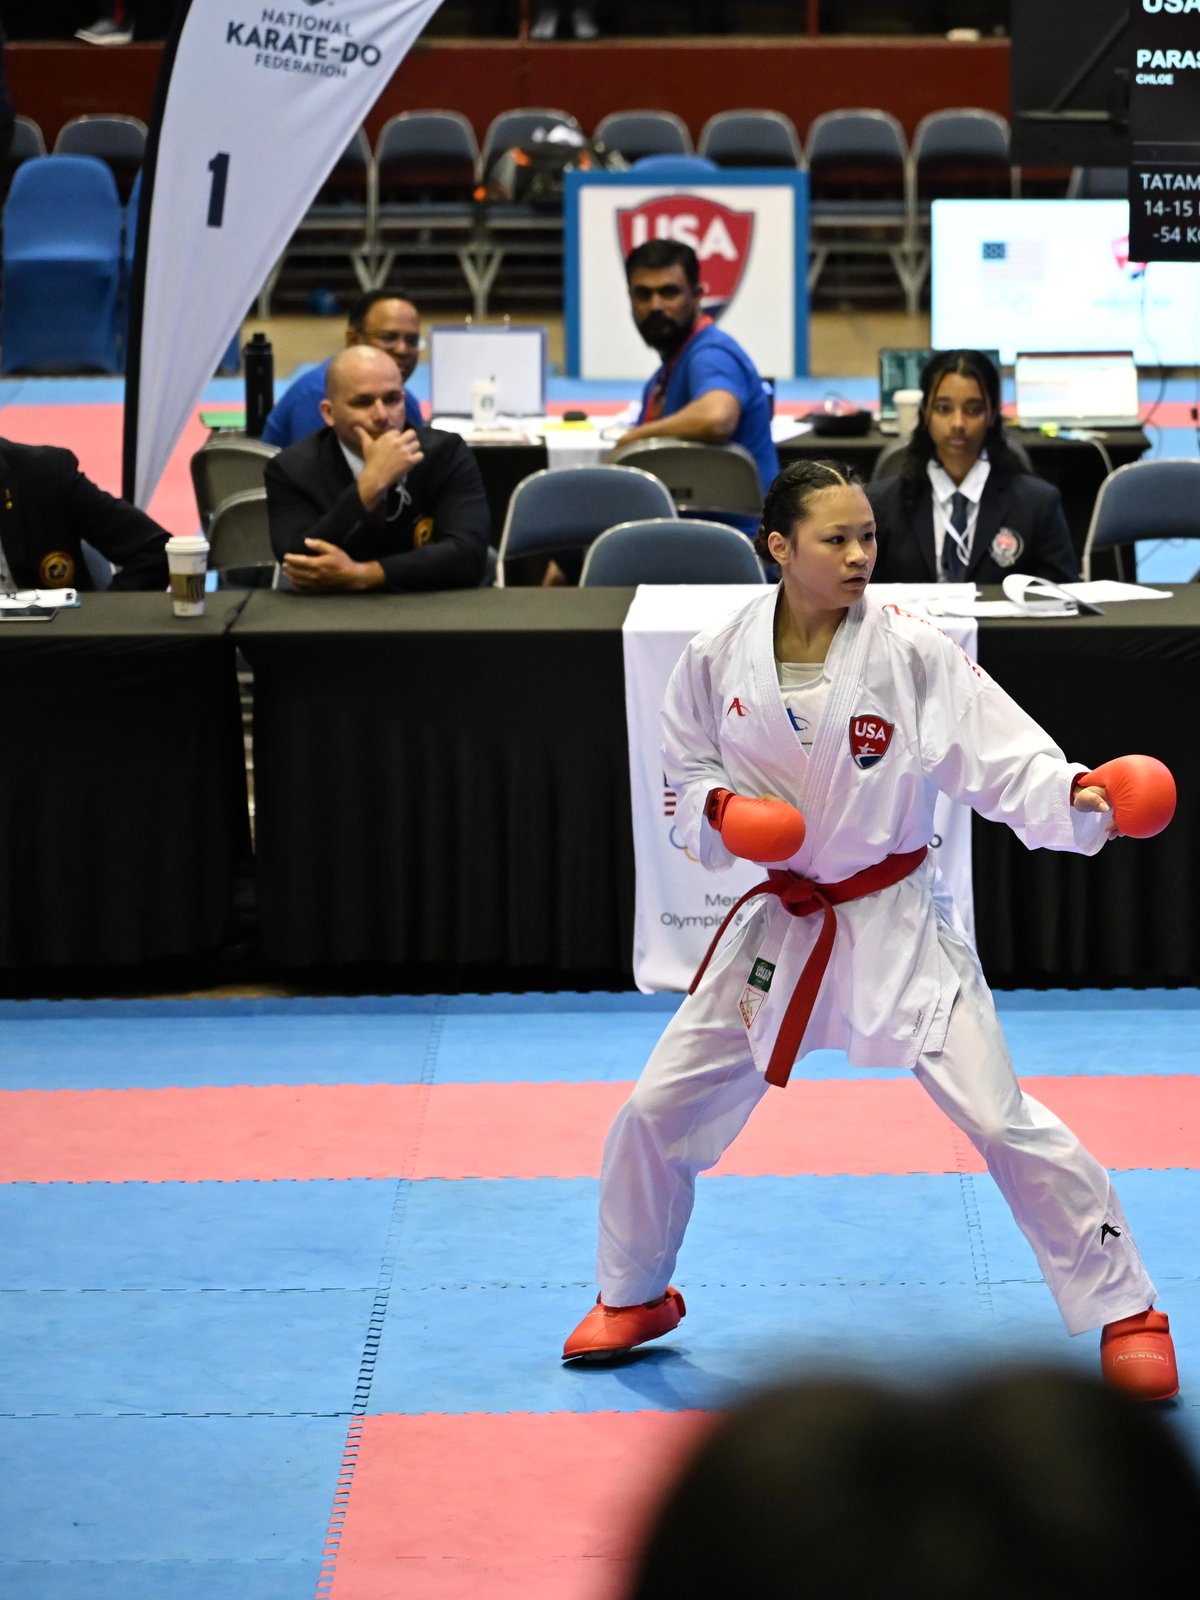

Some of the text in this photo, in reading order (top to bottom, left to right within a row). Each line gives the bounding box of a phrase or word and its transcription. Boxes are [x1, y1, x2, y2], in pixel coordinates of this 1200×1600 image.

[261, 8, 354, 37] NATIONAL
[226, 21, 382, 67] KARATE-DO
[254, 53, 348, 78] FEDERATION
[207, 152, 230, 228] 1
[1144, 200, 1193, 217] 14-15
[1152, 226, 1181, 243] -54
[854, 720, 887, 742] USA
